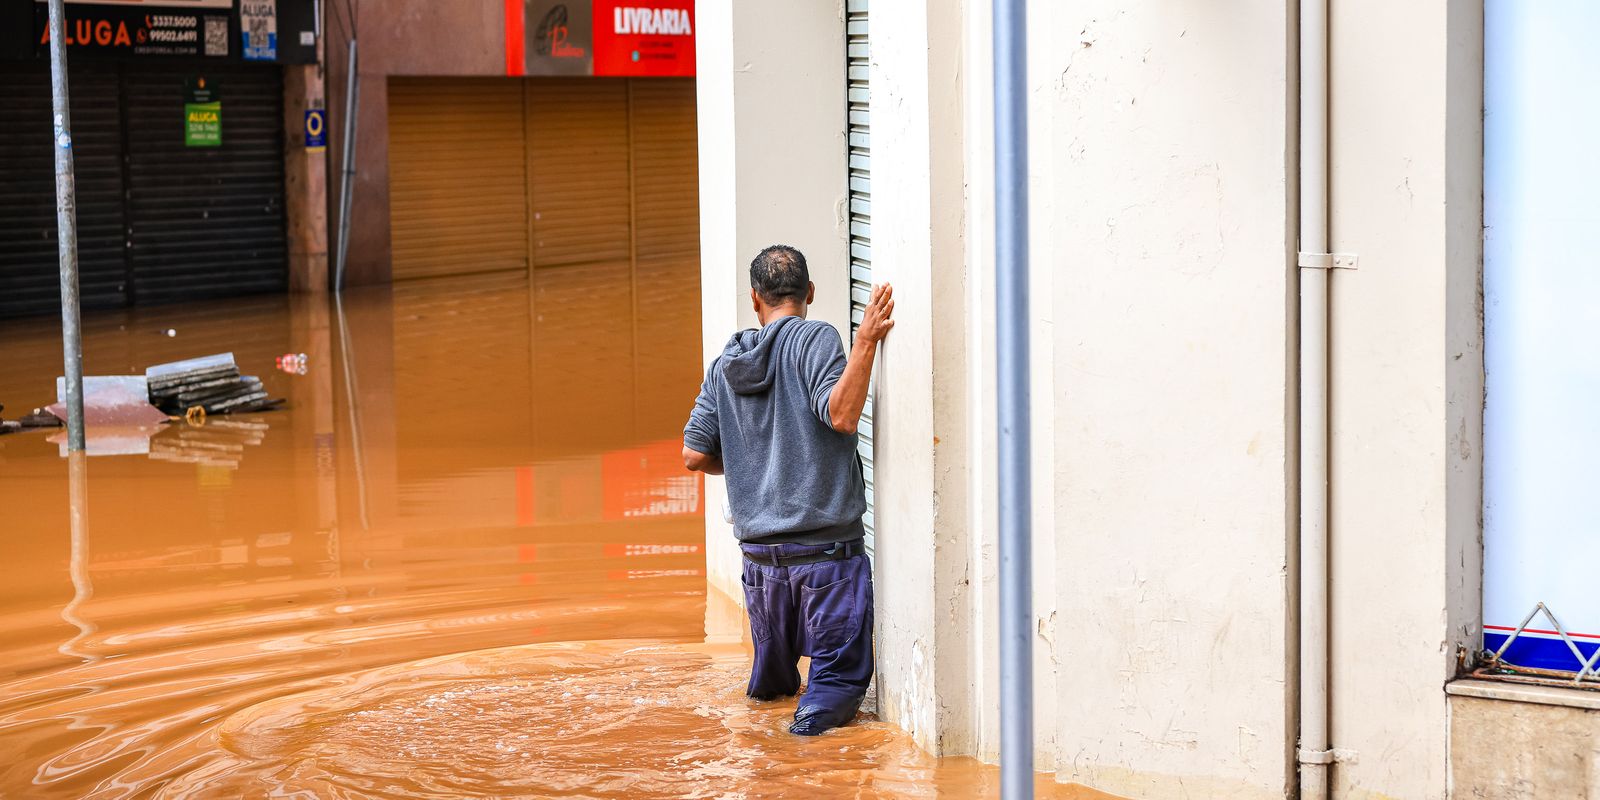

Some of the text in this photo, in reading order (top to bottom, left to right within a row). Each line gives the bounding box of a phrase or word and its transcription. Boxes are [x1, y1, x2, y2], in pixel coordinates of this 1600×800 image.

[242, 3, 273, 17] ALUGA
[152, 15, 197, 28] 3337.5000
[614, 7, 691, 35] LIVRARIA
[40, 18, 131, 47] ALUGA
[189, 111, 218, 122] ALUGA
